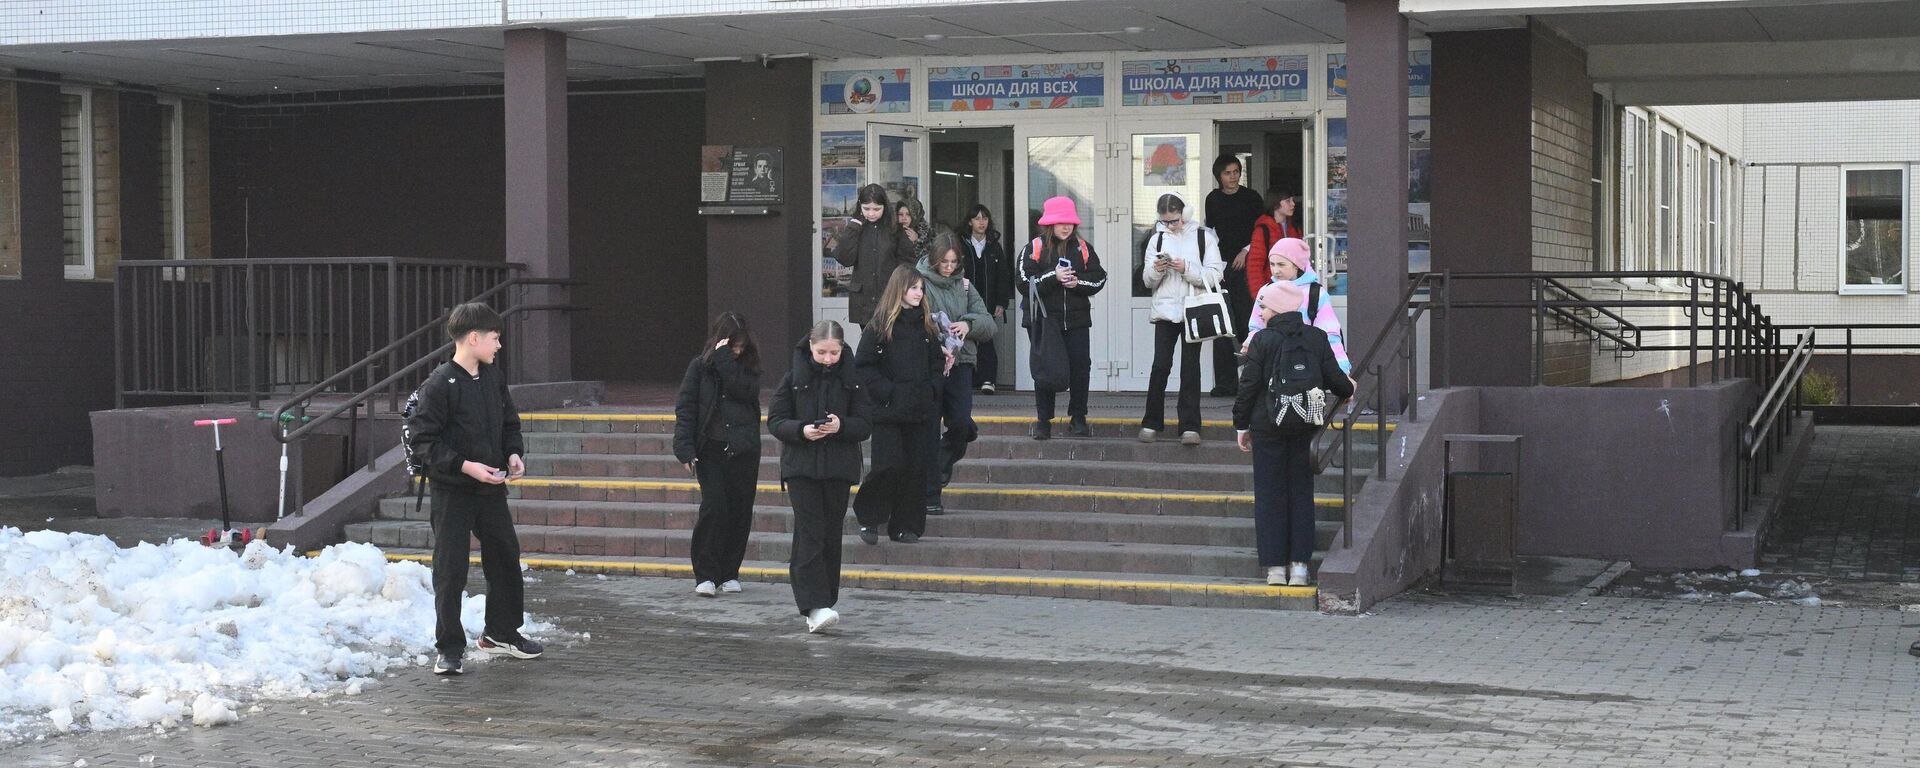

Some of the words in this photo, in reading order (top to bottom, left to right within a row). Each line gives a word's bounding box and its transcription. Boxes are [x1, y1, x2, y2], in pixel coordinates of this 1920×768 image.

[952, 84, 1005, 96] ШКОЛА
[1008, 83, 1038, 97] ДЛЯ
[1043, 80, 1078, 93] ВСЕХ
[1129, 77, 1185, 90] ШКОЛА
[1188, 77, 1220, 91] ДЛЯ
[1225, 73, 1300, 88] КАЖДОГО
